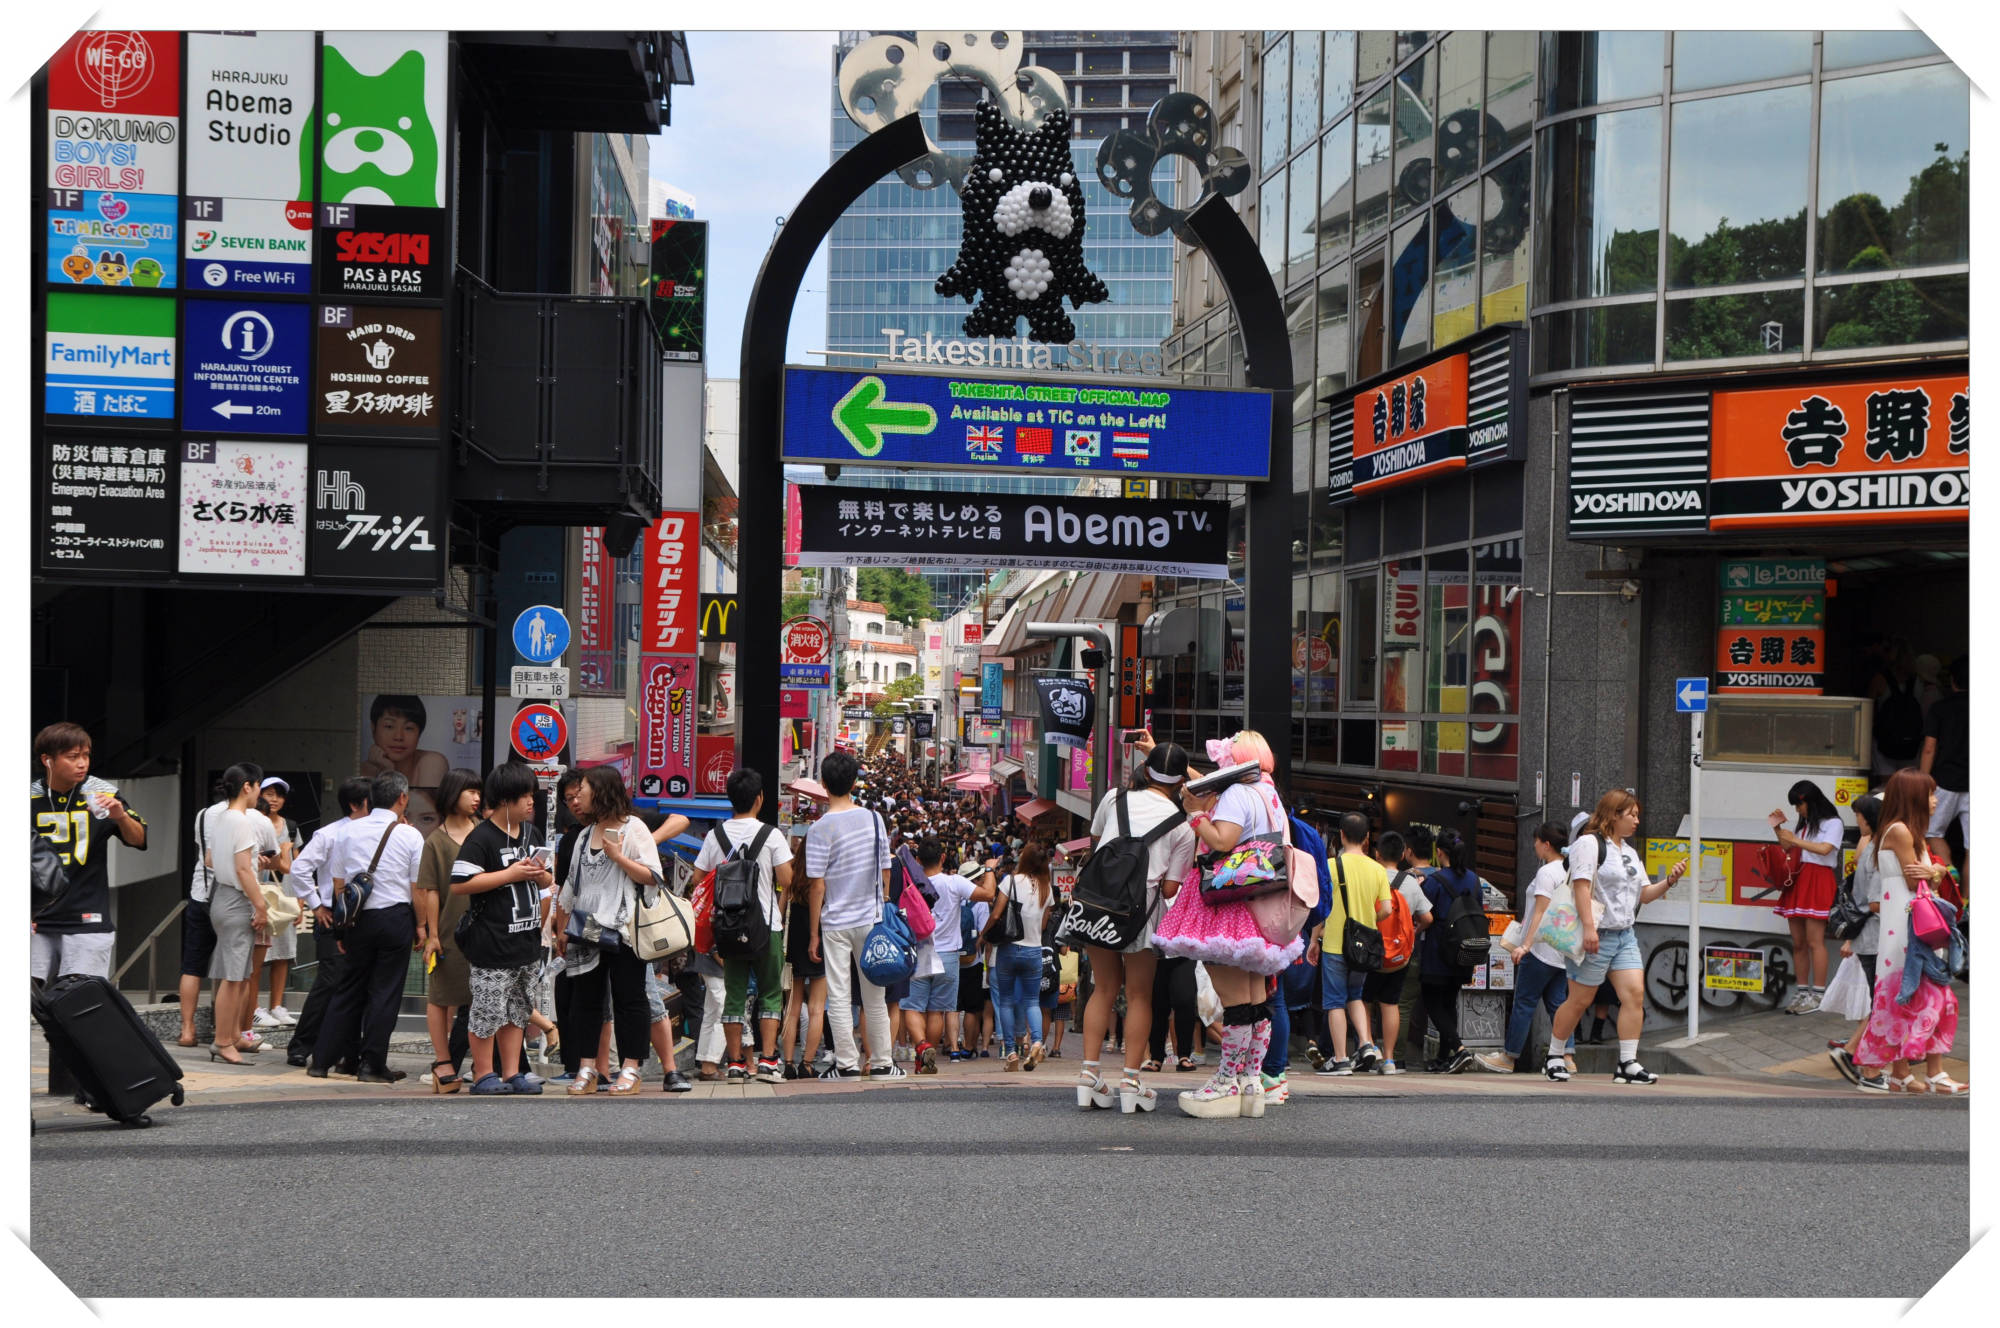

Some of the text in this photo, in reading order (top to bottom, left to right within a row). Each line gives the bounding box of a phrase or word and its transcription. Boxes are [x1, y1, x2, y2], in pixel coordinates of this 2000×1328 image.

[86, 48, 114, 68] WE
[212, 70, 288, 86] HARAJUKU
[206, 89, 292, 115] Abema
[55, 116, 176, 144] DOKUMO
[208, 120, 290, 146] Studio
[54, 141, 137, 166] BOYS!
[55, 165, 145, 190] GIRLS!
[54, 190, 78, 207] 1F
[194, 200, 214, 218] 1F
[326, 206, 349, 224] 1F
[52, 218, 172, 240] TAMAGOTCHI
[220, 236, 306, 251] SEVEN BANK
[336, 230, 430, 265] SASAKI
[234, 270, 295, 284] Free Wi-Fi
[344, 268, 422, 284] PAS à PAS
[344, 282, 422, 292] HARAJUKU SASAKI
[324, 307, 346, 324] BF
[346, 324, 416, 340] HAND DRIP
[50, 343, 172, 368] FamilyMart
[882, 328, 1171, 376] Takeshita Street
[194, 372, 300, 384] INFORMATION CENTER
[200, 362, 292, 374] HARAJUKU TOURIST
[330, 373, 429, 385] HOSHINO COFFEE
[74, 390, 148, 414] 酒 たばこ
[325, 390, 434, 418] 星乃珈琲
[949, 382, 1170, 408] TAKESHITA STREET OFFICIAL MAP
[256, 406, 281, 415] 20m
[950, 405, 1167, 429] Available at TIC on the Left!
[1373, 375, 1427, 446] 吉野家
[1469, 422, 1508, 448] YOSHINOYA
[52, 444, 166, 465] 防災備蓄倉庫
[187, 443, 210, 459] BF
[1372, 440, 1426, 476] YOSHINOYA
[52, 482, 165, 498] Emergency Evacuation Area
[317, 470, 365, 510] Hh
[192, 500, 294, 525] さくら水産
[838, 500, 1002, 523] 無料で楽しめる
[1574, 490, 1702, 514] YOSHINOYA
[336, 514, 436, 551] アッシュ
[838, 524, 1001, 540] インターネットテレビ局
[656, 517, 684, 648] OSドラッグ
[790, 633, 820, 648] 消火栓
[1728, 637, 1816, 665] 吉野家
[514, 671, 566, 682] 自転車を除く
[1728, 673, 1814, 687] YOSHINOYA
[516, 684, 528, 695] 11
[552, 685, 562, 695] 18
[672, 718, 680, 752] STUDIO
[683, 689, 692, 768] ENTERTAINMENT
[670, 780, 686, 793] B1
[1057, 876, 1075, 884] NO
[1065, 900, 1122, 944] Barbie
